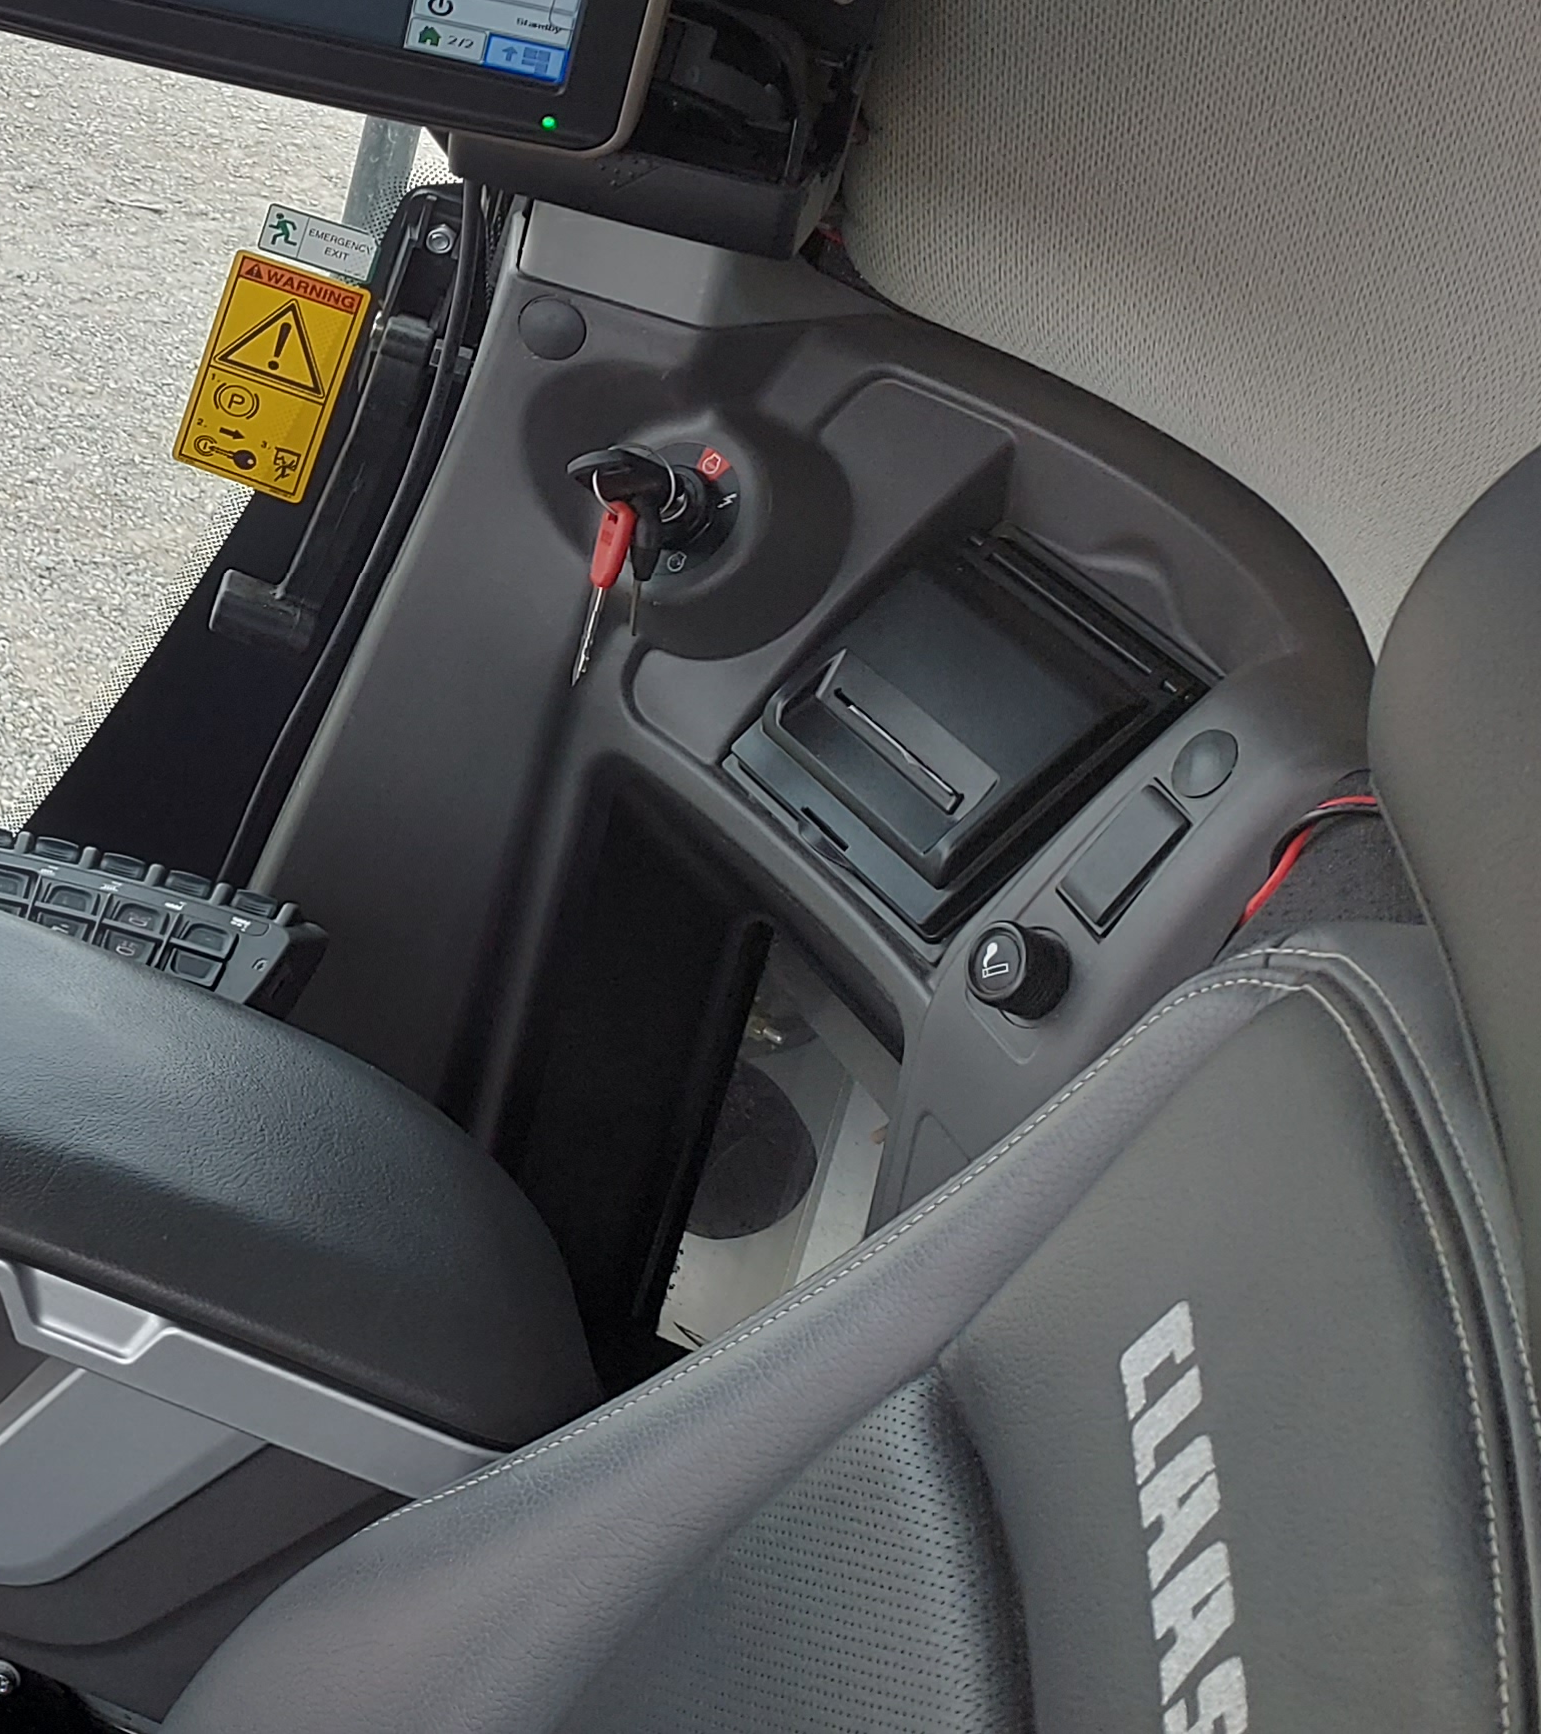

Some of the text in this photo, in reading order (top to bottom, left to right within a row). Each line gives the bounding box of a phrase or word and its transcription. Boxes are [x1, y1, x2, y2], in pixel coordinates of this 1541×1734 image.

[516, 17, 563, 35] Standby
[447, 34, 475, 50] 2/2
[308, 228, 374, 256] EMERGENCY
[324, 246, 350, 262] EXIT
[267, 269, 356, 310] WARNING
[228, 393, 245, 409] P
